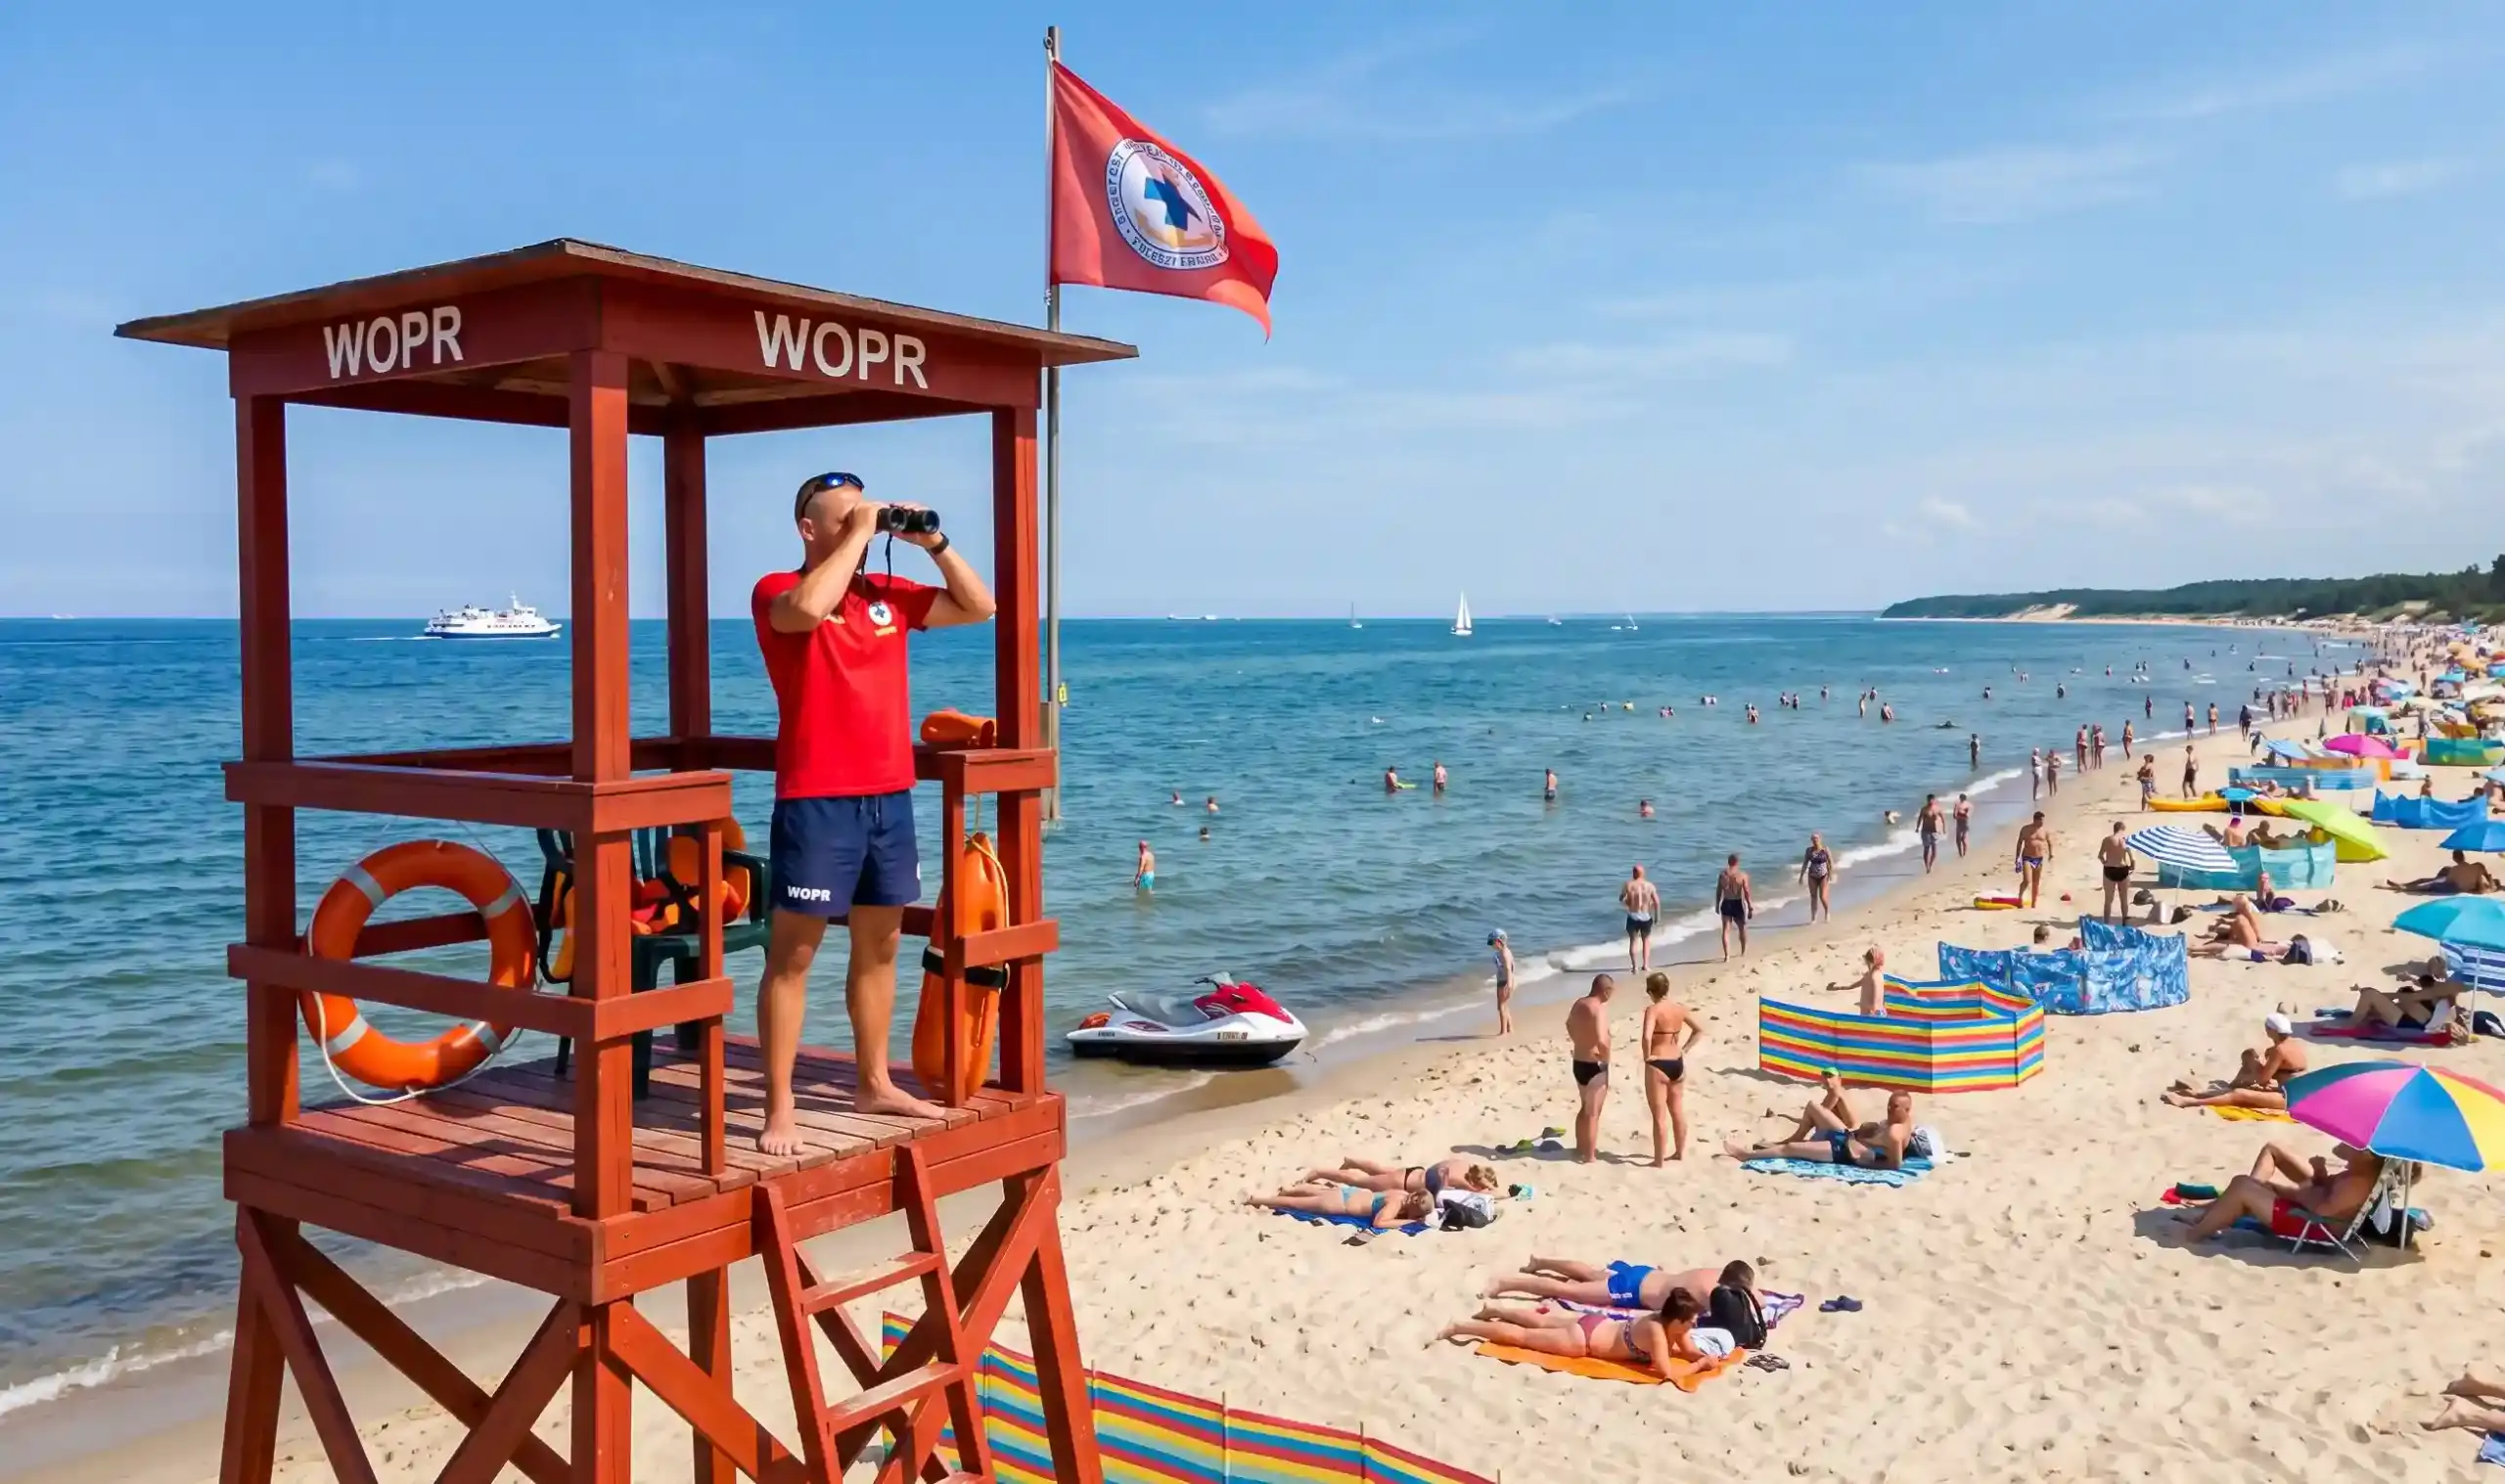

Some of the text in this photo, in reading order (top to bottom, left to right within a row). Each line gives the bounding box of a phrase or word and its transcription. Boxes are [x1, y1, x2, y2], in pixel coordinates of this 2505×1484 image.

[323, 305, 464, 379] WOPR
[753, 310, 929, 389] WOPR
[787, 885, 831, 902] WOPR
